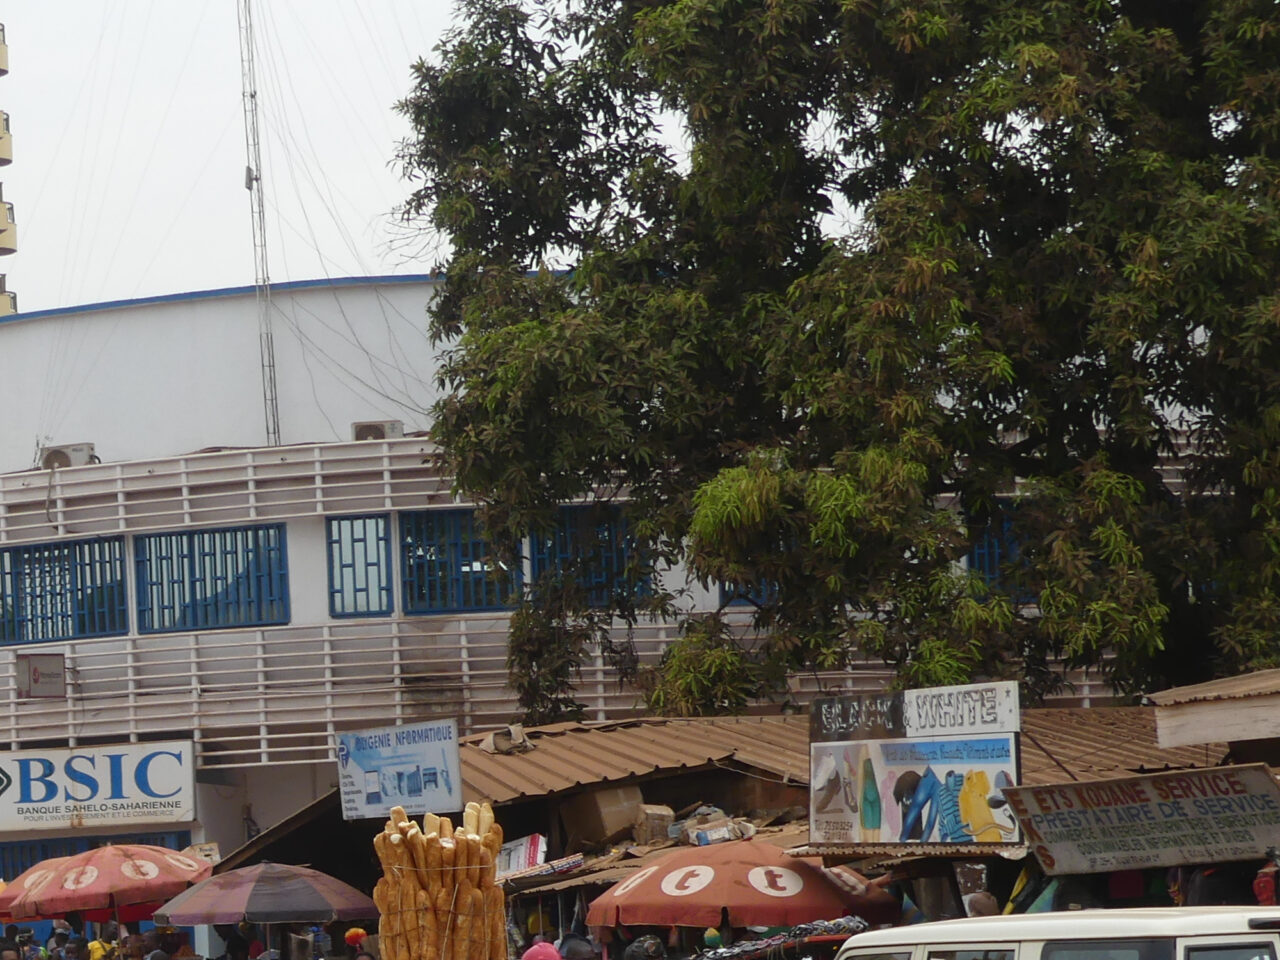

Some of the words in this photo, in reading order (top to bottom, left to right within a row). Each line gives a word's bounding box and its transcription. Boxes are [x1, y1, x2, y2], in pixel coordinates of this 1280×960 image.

[822, 700, 893, 733] BLACK
[916, 688, 997, 729] WHITE
[12, 750, 183, 803] BSIC
[1033, 789, 1074, 813] ETS
[1152, 773, 1247, 800] SERVICE
[17, 806, 62, 815] BANQUE
[65, 801, 182, 813] SAHELO-SAHARIENNE
[1032, 802, 1155, 830] PRESTATAIRE
[1158, 800, 1188, 818] DE
[1193, 794, 1279, 815] SERVICE
